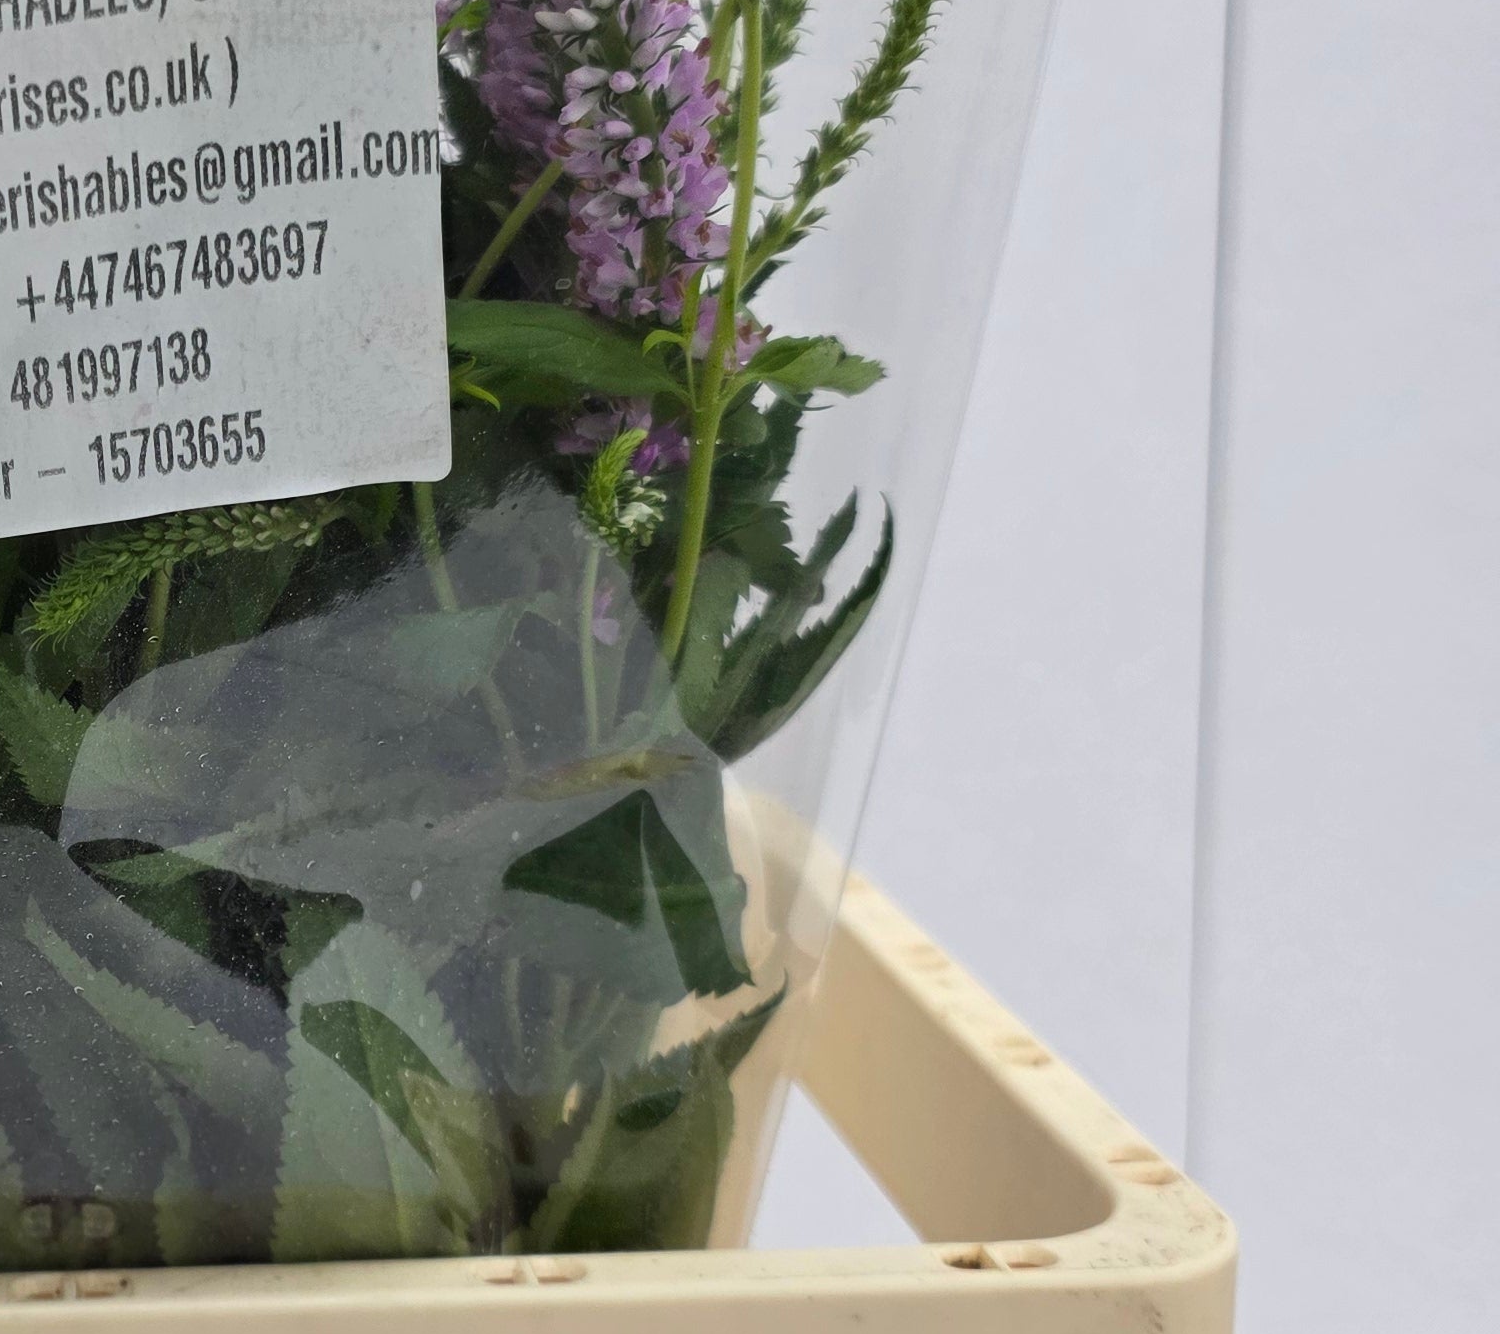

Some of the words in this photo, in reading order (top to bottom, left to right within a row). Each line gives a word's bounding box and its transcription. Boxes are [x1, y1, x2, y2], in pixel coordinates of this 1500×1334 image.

[14, 219, 331, 328] +447467483697
[10, 326, 212, 411] 481997138
[88, 408, 266, 486] 15703655
